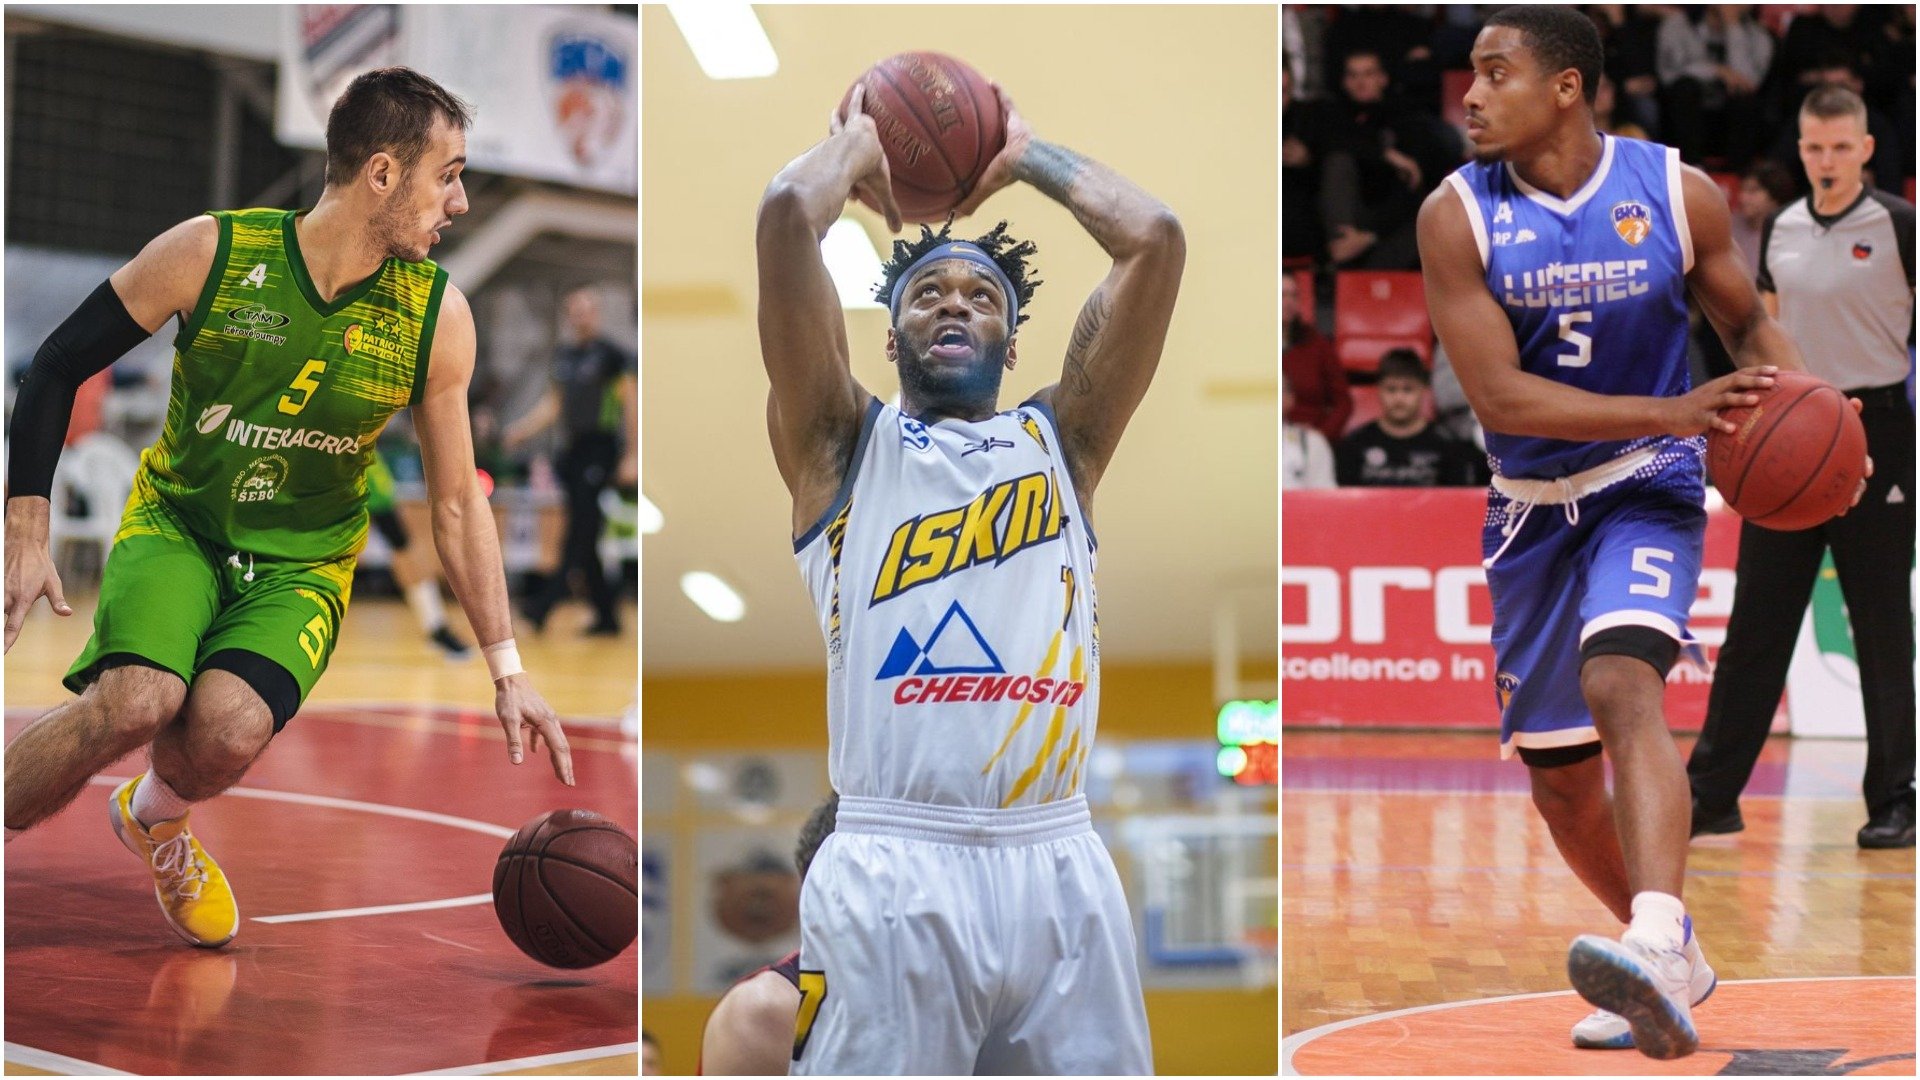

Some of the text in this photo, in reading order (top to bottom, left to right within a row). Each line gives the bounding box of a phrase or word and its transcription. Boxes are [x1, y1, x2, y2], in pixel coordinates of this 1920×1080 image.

[254, 330, 287, 346] pumpy
[1557, 311, 1593, 368] 5
[277, 358, 328, 416] 5
[225, 418, 363, 455] INTERAGROS
[238, 488, 274, 502] ŠEBO
[1629, 547, 1675, 599] 5
[298, 613, 329, 670] 5
[1451, 652, 1485, 682] in
